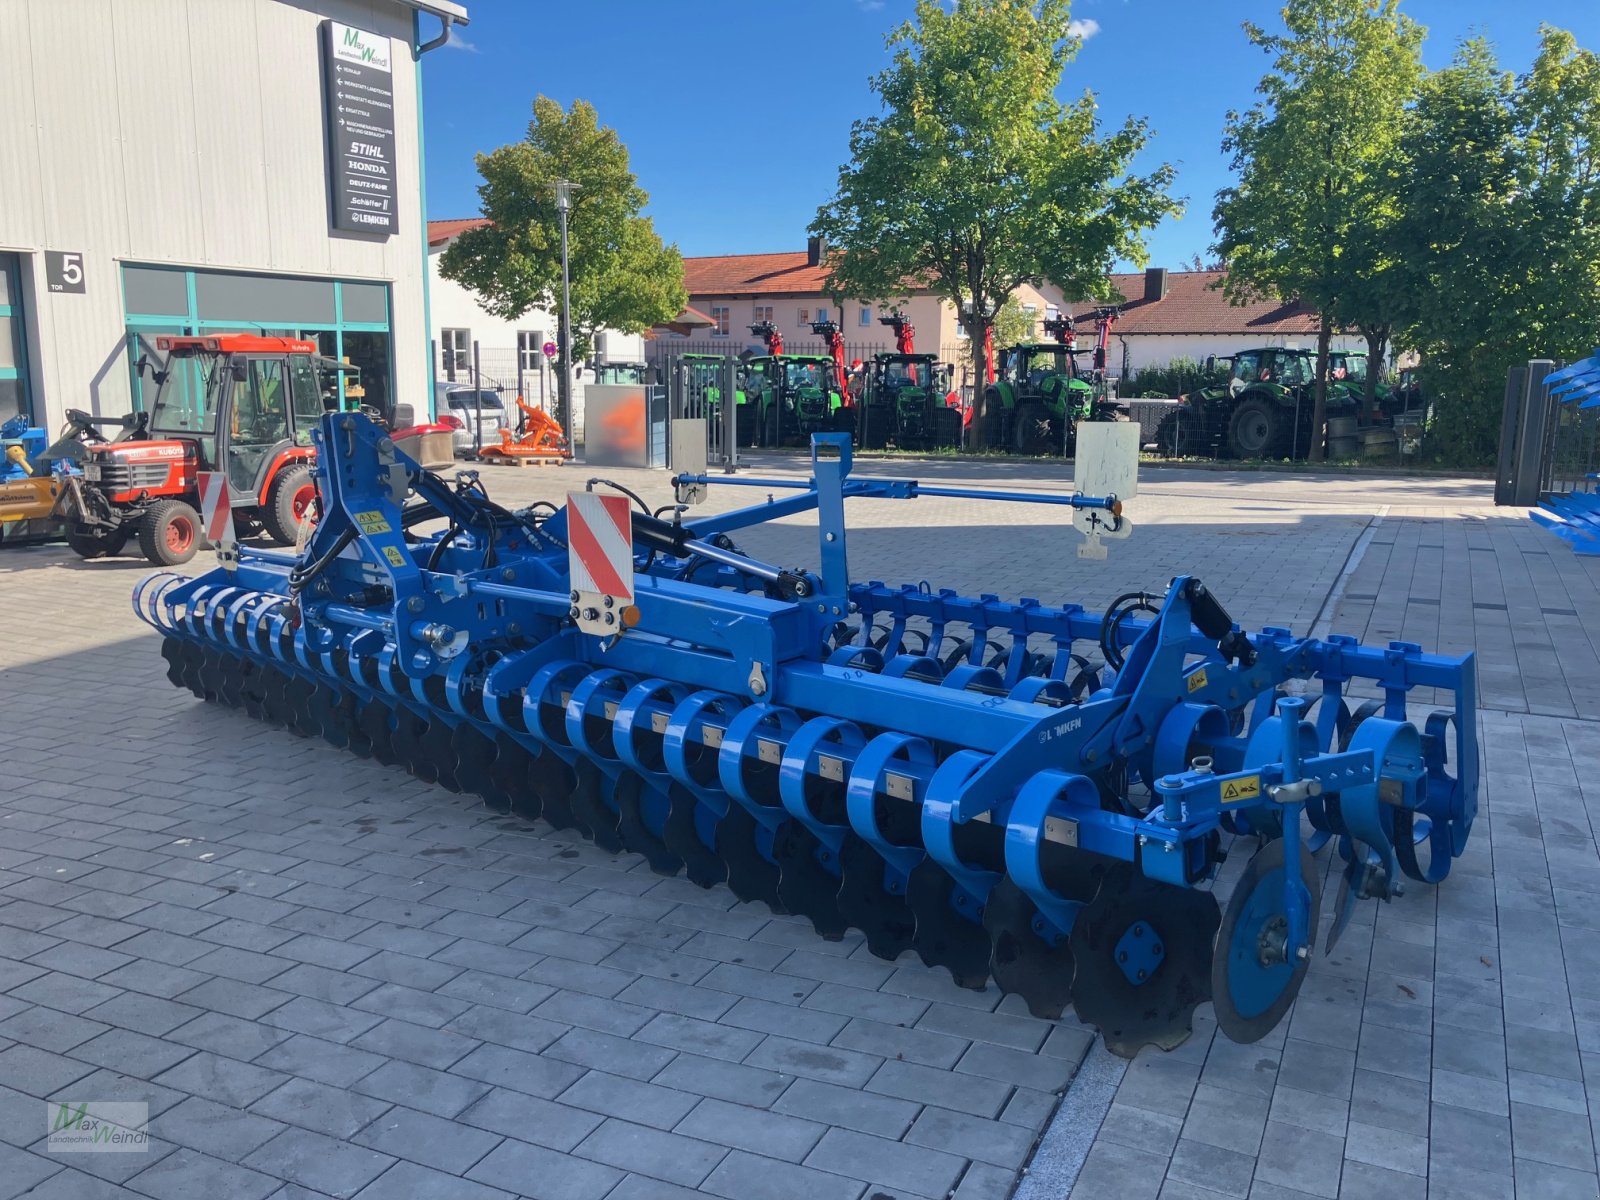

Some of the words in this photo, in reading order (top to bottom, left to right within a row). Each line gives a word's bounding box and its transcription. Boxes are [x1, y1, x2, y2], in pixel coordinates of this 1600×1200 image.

[344, 28, 365, 49] Max
[361, 47, 387, 67] Weindl
[350, 142, 384, 158] STIHL
[348, 161, 387, 174] HONDA
[349, 179, 388, 191] DEUTZ-FAHR
[359, 214, 389, 226] LEMKEN
[63, 255, 82, 284] 5
